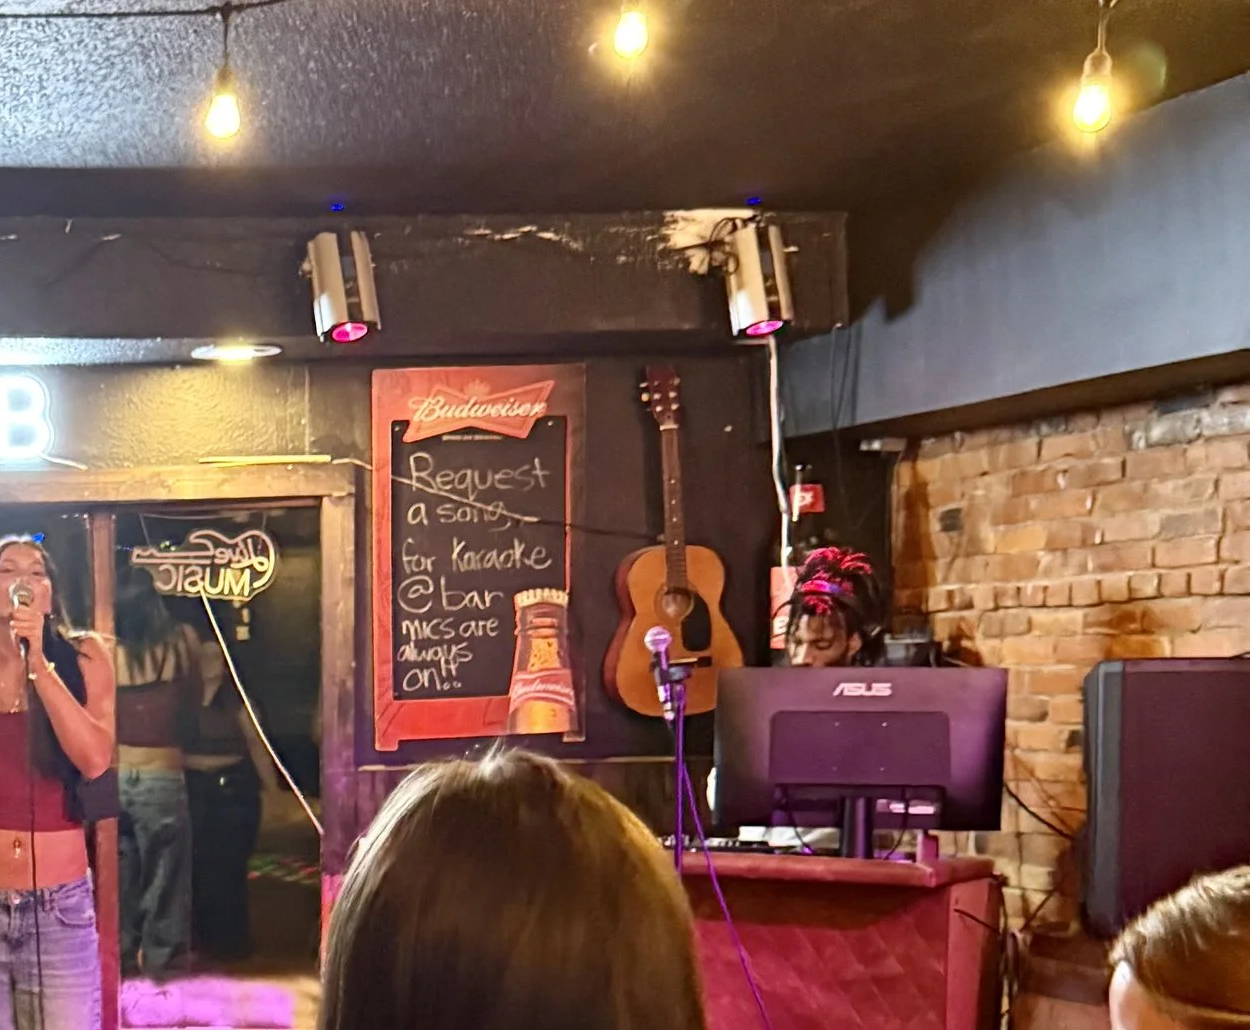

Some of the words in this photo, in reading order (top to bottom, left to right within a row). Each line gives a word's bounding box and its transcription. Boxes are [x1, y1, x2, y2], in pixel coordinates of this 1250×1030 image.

[408, 395, 547, 423] Budweiser
[408, 452, 550, 501] Request
[406, 502, 429, 527] a
[401, 537, 436, 574] for
[397, 575, 434, 613] @
[440, 575, 504, 612] bar
[459, 618, 499, 638] are
[833, 682, 893, 697] ASUS
